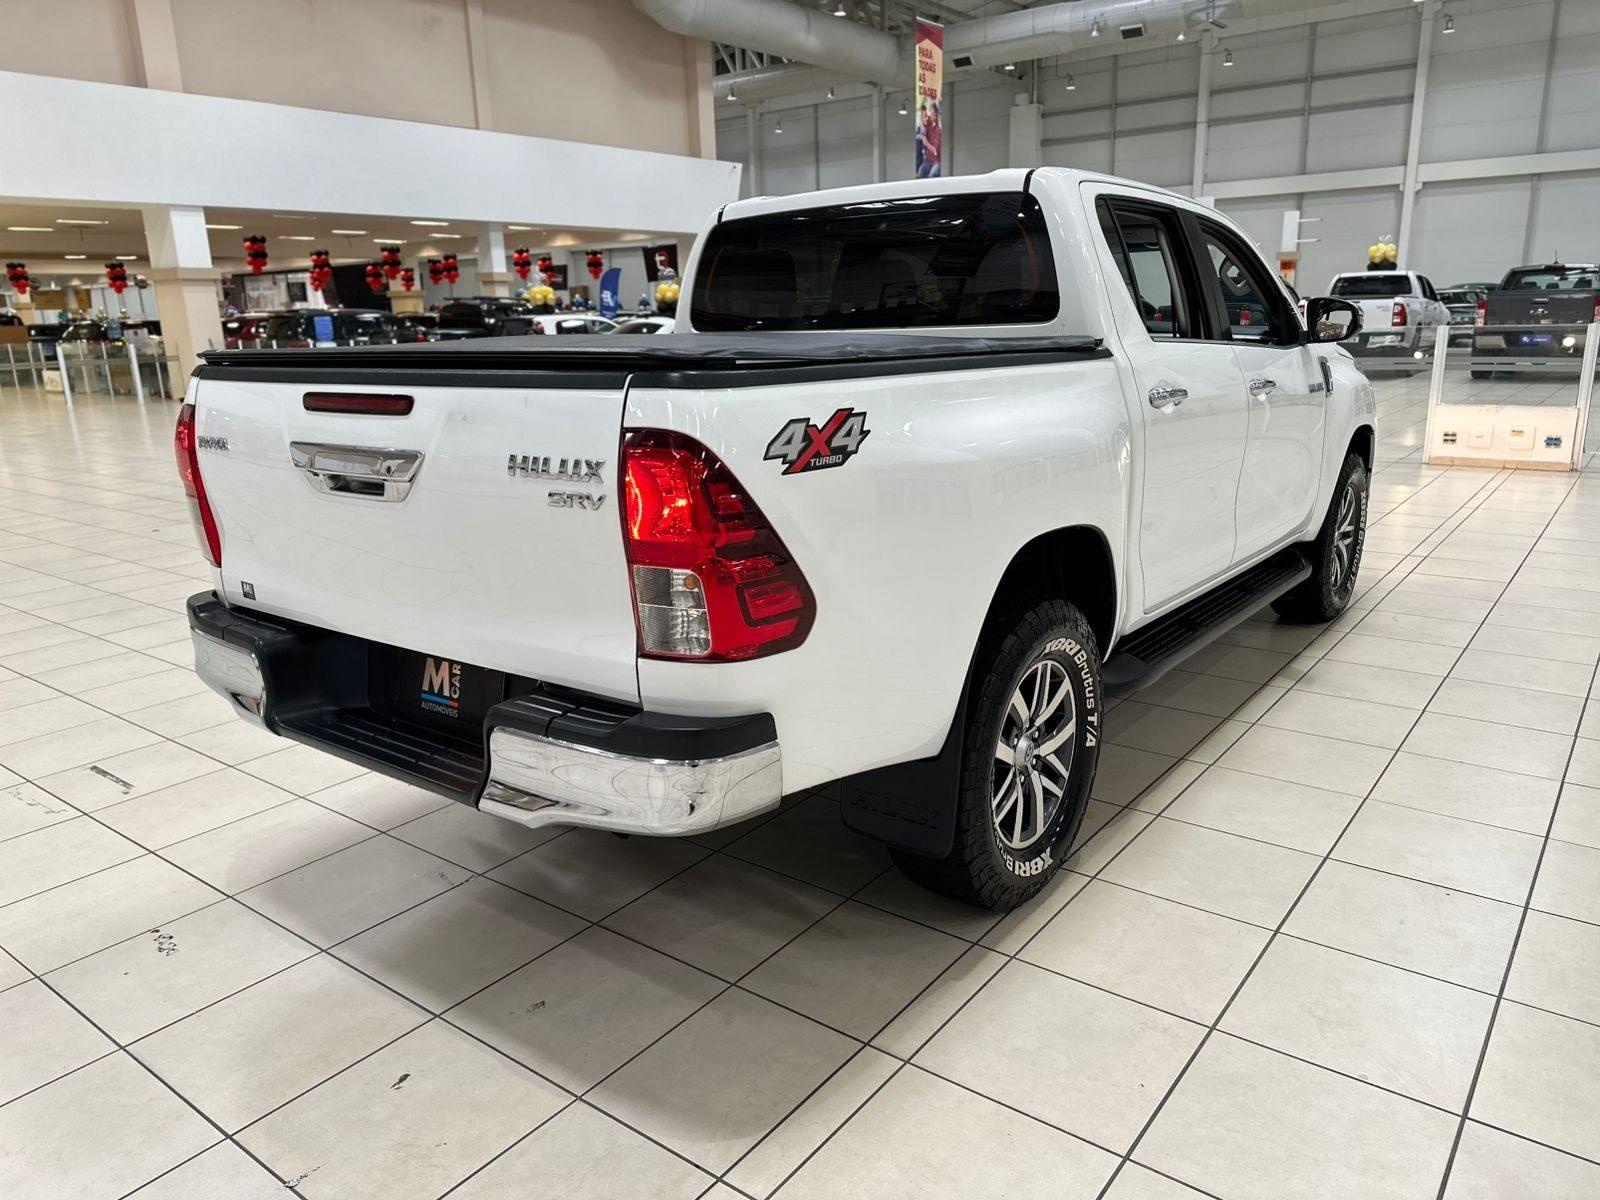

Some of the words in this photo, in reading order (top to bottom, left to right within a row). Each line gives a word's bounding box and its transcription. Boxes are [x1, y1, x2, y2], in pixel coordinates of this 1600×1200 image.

[918, 46, 933, 60] PARA
[918, 59, 936, 73] TODAS
[918, 73, 926, 83] AS
[507, 454, 606, 484] HILUX
[810, 455, 843, 467] TURBO
[547, 490, 607, 511] SRV
[1073, 649, 1096, 710] Brutus
[1085, 712, 1098, 747] T/A
[1014, 846, 1054, 877] XBRI
